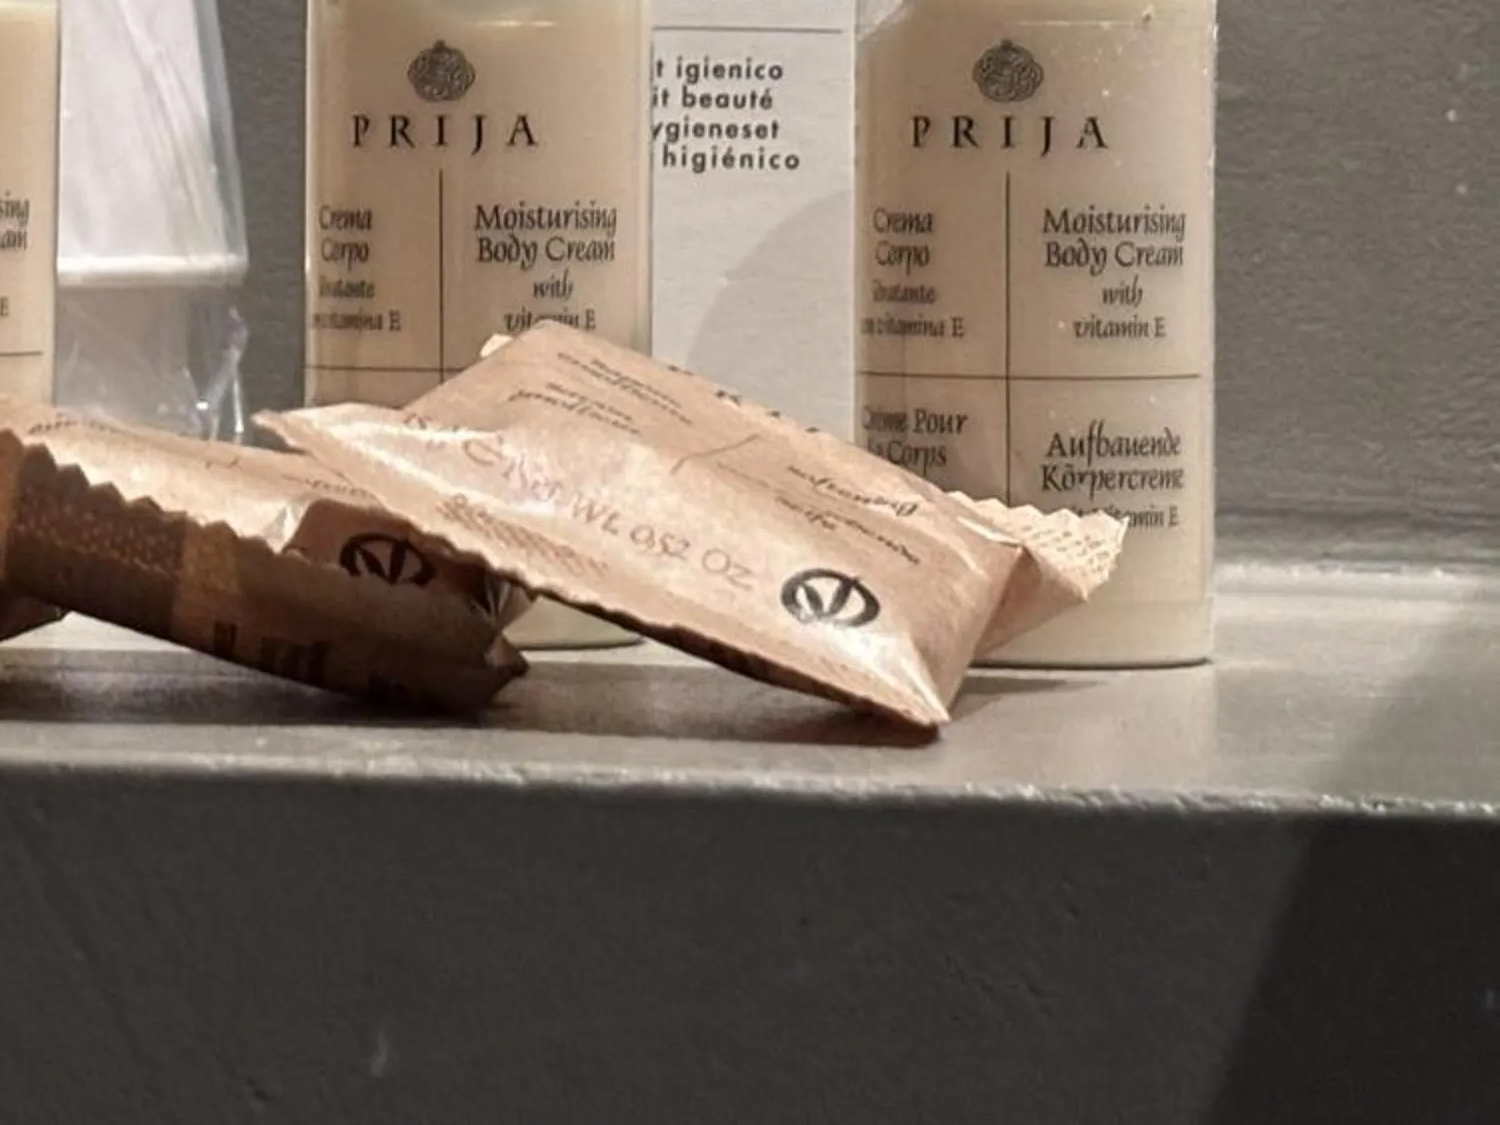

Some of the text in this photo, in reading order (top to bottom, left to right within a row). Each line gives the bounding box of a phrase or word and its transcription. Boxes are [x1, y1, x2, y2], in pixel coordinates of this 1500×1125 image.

[676, 55, 785, 85] igienico
[681, 84, 774, 110] beauté
[351, 113, 540, 156] PRIJA
[911, 114, 1110, 156] PRIJA
[662, 144, 801, 175] higiénico
[475, 200, 618, 237] Moisturising
[1043, 203, 1187, 243] Moisturising
[477, 233, 616, 272] Body Cream
[1044, 237, 1184, 276] Body Cream
[533, 267, 574, 300] with
[1102, 273, 1144, 308] with
[0, 296, 10, 318] E
[585, 309, 597, 331] E
[951, 316, 966, 337] E
[1074, 314, 1168, 339] vitamin E
[912, 407, 969, 435] Pour
[1044, 418, 1182, 467] Aufbauende
